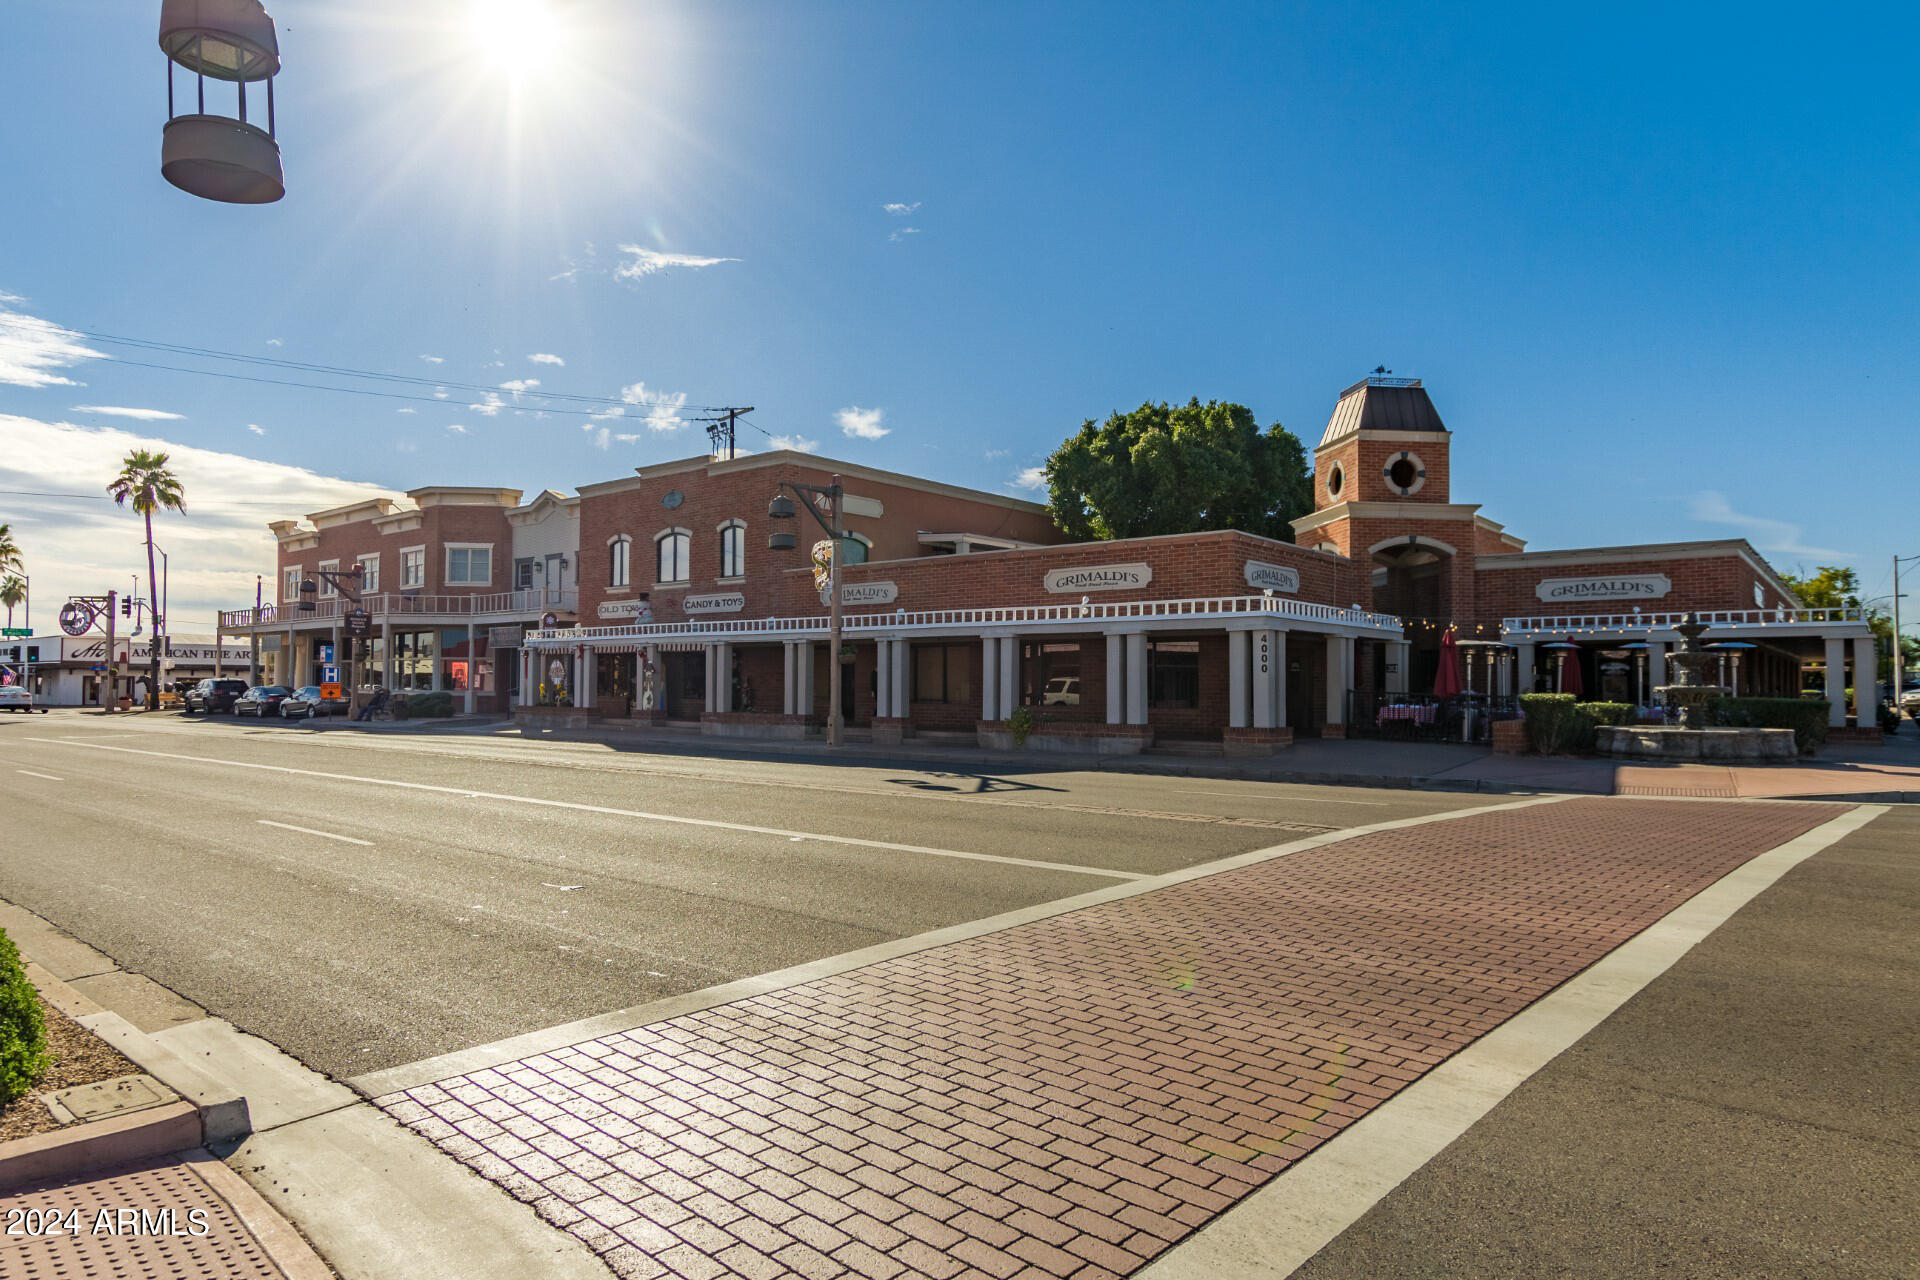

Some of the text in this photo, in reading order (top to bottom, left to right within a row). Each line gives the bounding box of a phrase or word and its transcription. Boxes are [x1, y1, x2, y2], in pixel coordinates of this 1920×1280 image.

[1056, 571, 1139, 588] GRIMALDI'S
[1251, 570, 1293, 588] GRIMALDI'S
[1551, 581, 1655, 597] GRIMALDI'S
[621, 604, 639, 612] TOW
[685, 598, 744, 609] CANDY & TOYS
[131, 648, 198, 658] AMICAN
[234, 650, 252, 659] AR
[1260, 633, 1268, 673] 4000
[325, 667, 338, 682] H
